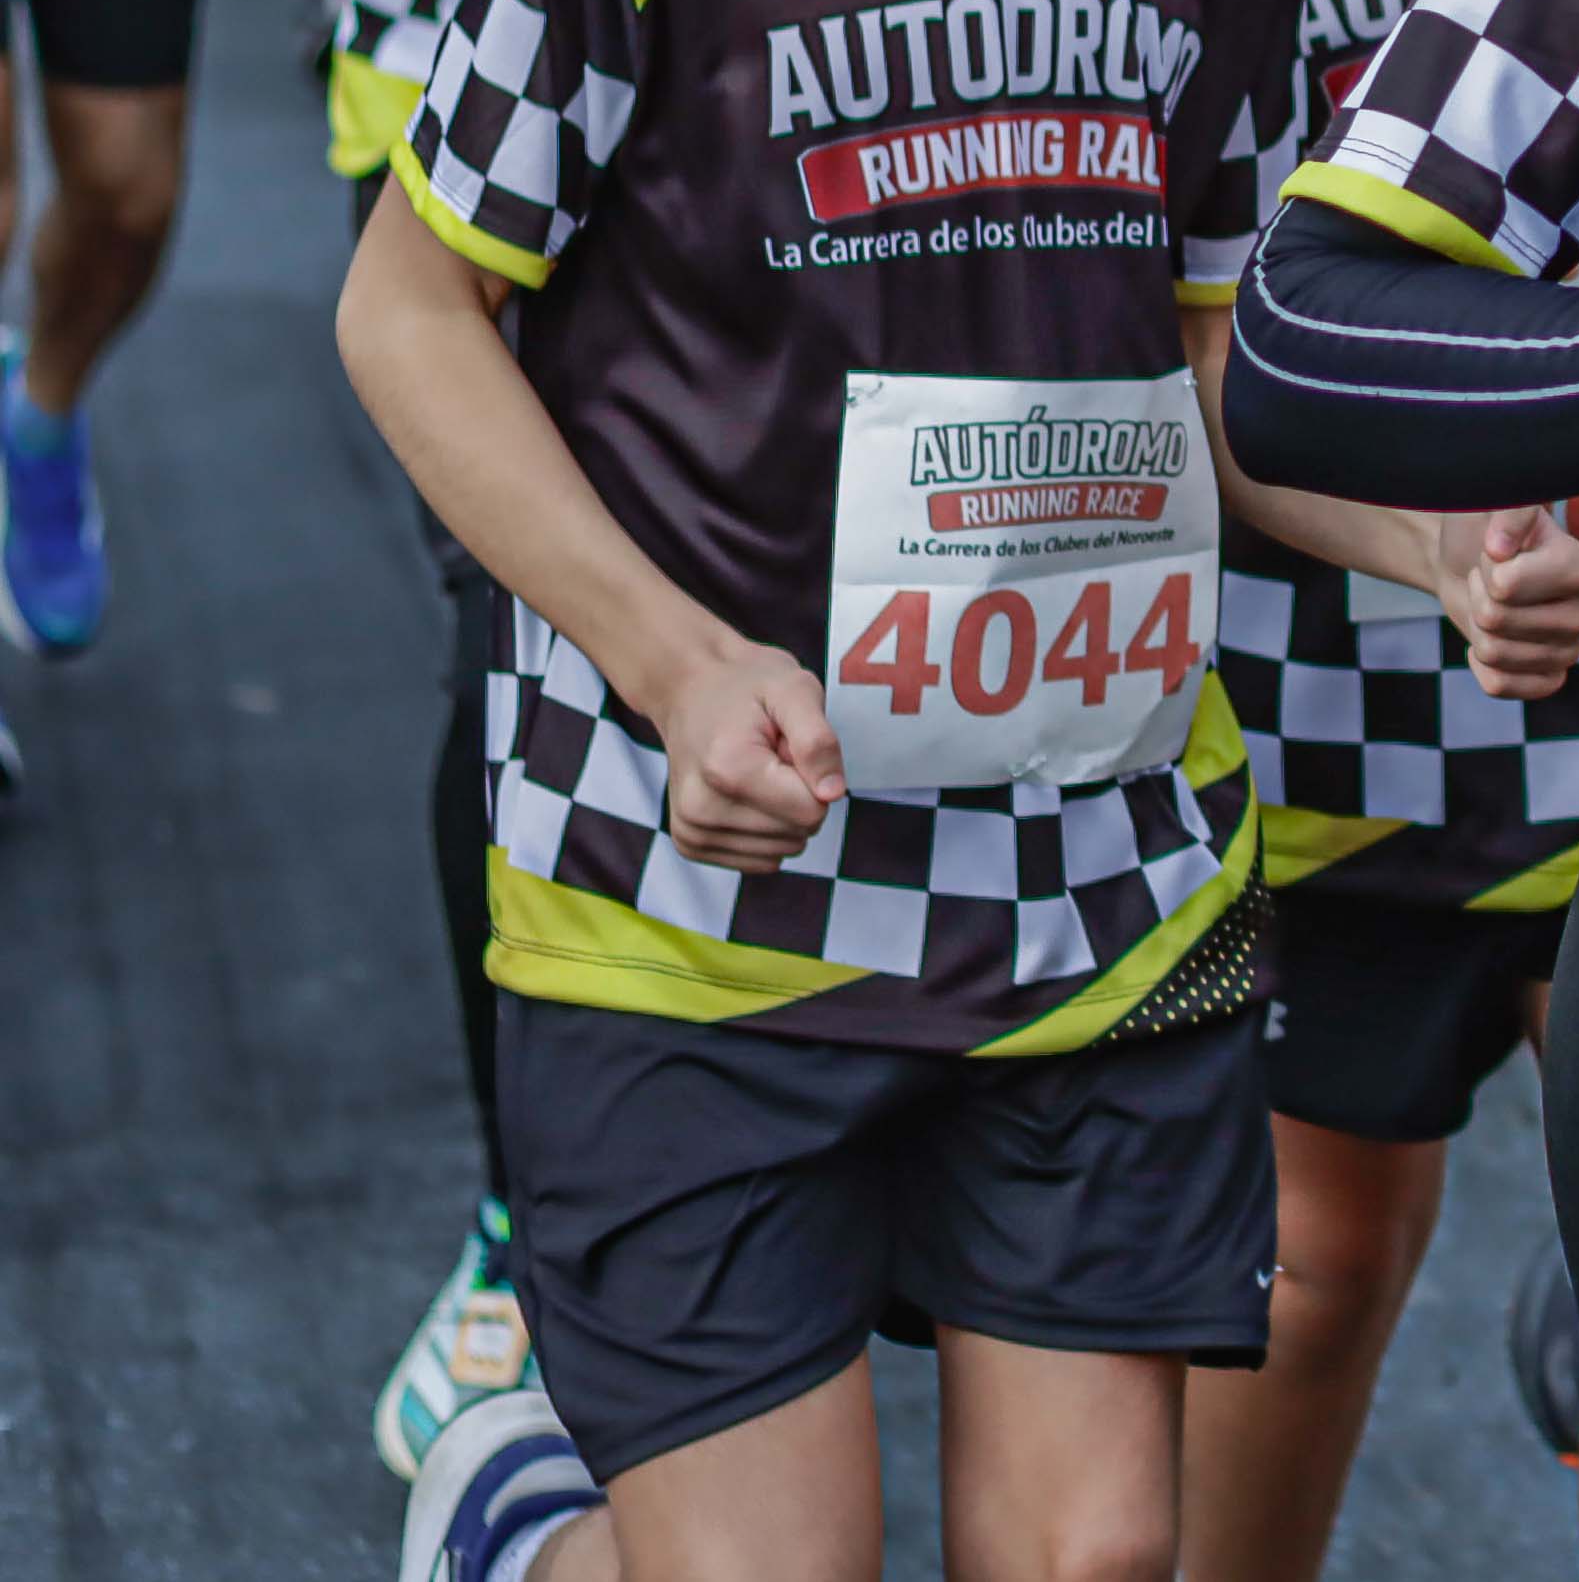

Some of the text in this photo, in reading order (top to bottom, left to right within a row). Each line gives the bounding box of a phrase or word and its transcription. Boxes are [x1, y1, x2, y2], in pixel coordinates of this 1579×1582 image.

[859, 118, 1064, 206] RUNNING
[764, 237, 802, 269] La
[809, 230, 921, 266] Carrera
[930, 221, 968, 252] de
[975, 216, 1014, 248] los
[1105, 212, 1153, 244] del
[910, 405, 1187, 486] AUTÓDROMO
[961, 486, 1144, 526] RUNNING RACE
[899, 528, 1175, 557] La Carrera de los Clubes del Noroeste
[839, 572, 1198, 716] 4044
